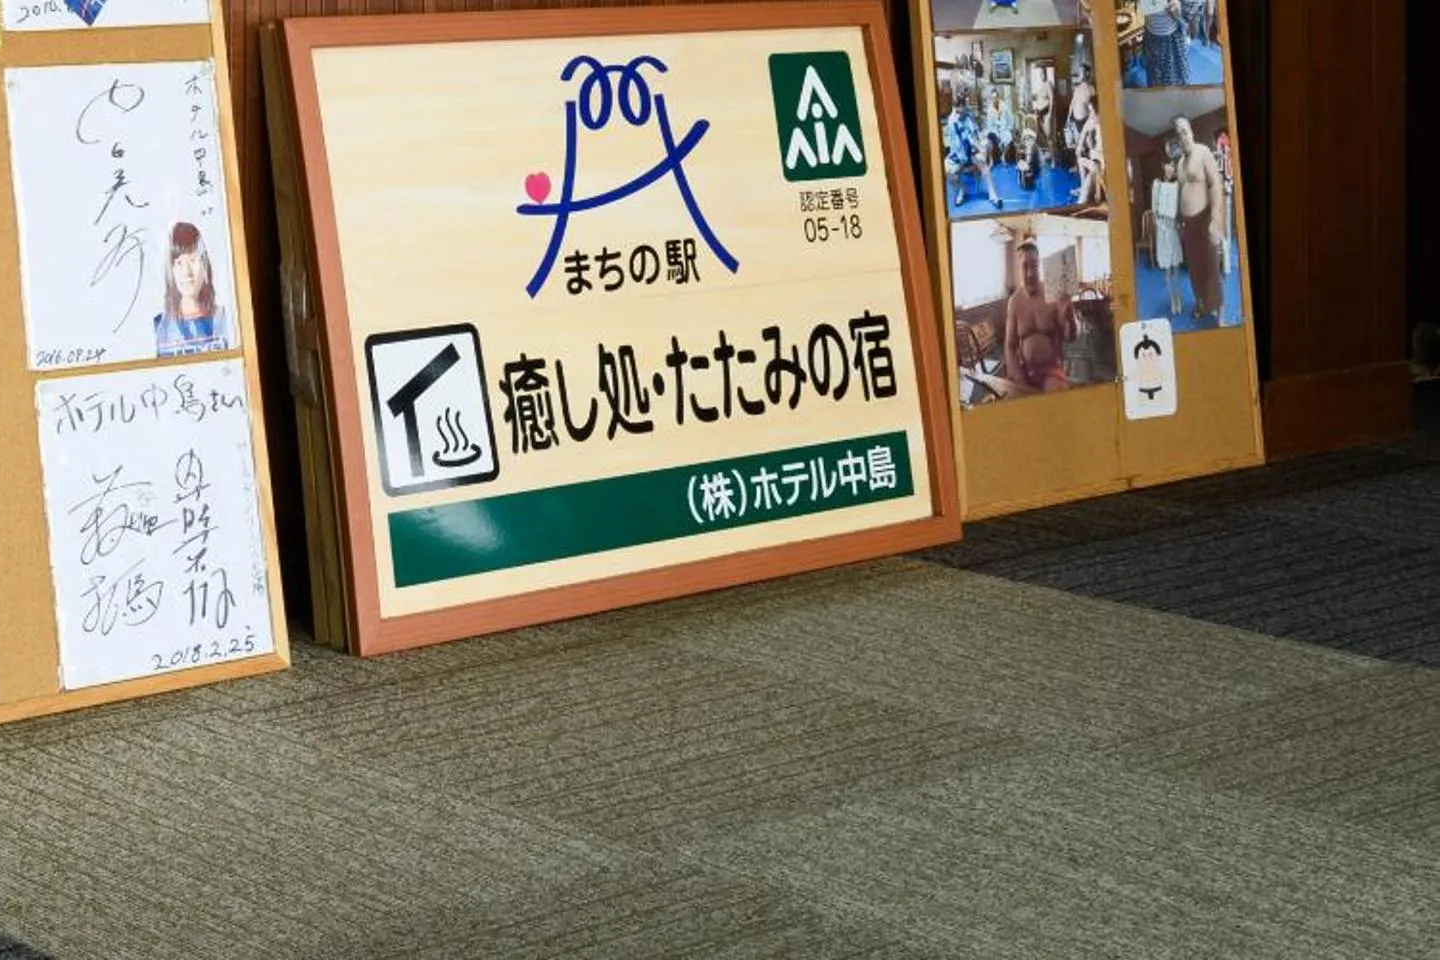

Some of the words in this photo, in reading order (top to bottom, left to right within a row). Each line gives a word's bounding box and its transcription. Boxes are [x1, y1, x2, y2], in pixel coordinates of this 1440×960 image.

[798, 188, 859, 212] 認定番号
[803, 215, 863, 243] 05-18
[563, 238, 700, 294] まちの駅
[498, 309, 898, 455] 癒し処・たたみの宿
[686, 445, 897, 525] (株)ホテル中島
[151, 634, 257, 671] 2018.2.25
